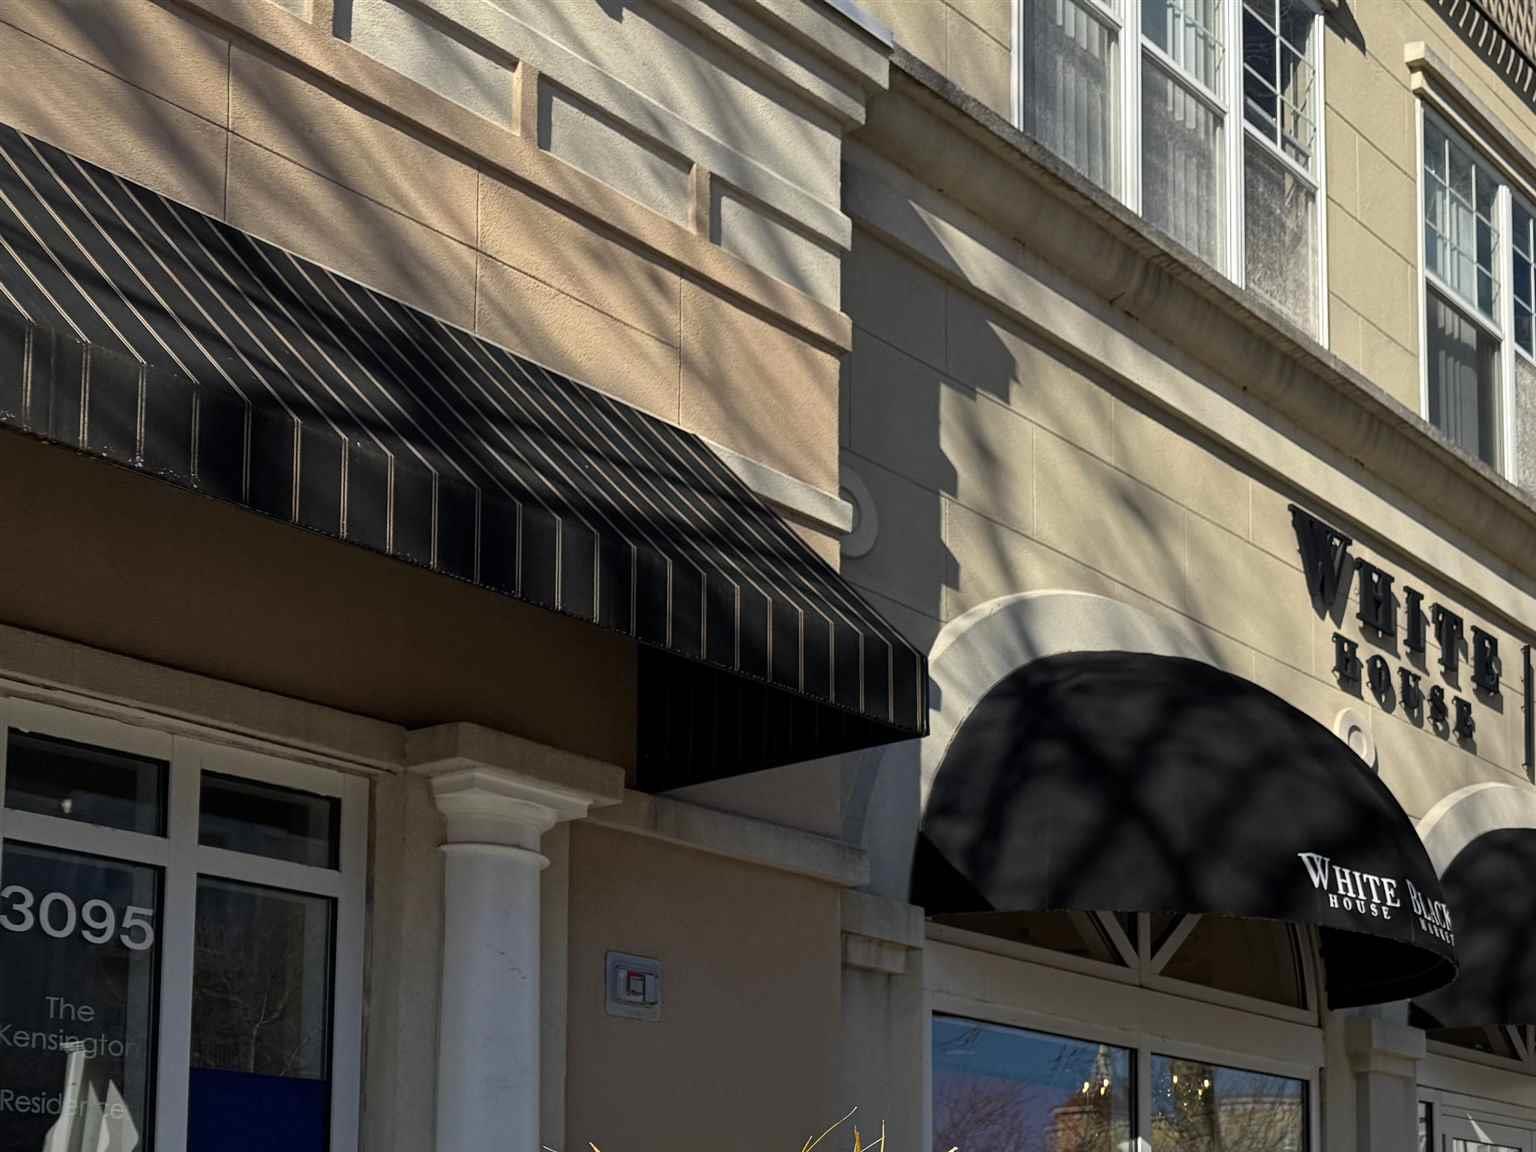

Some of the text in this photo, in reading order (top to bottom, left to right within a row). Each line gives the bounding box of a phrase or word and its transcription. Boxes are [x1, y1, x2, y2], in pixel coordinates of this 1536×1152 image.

[1288, 504, 1502, 706] WHITE
[1332, 632, 1476, 746] HOUSE
[0, 885, 155, 951] 3095
[1297, 852, 1453, 931] WHITE BLACK
[1328, 893, 1392, 920] HOUSE
[45, 996, 96, 1022] The
